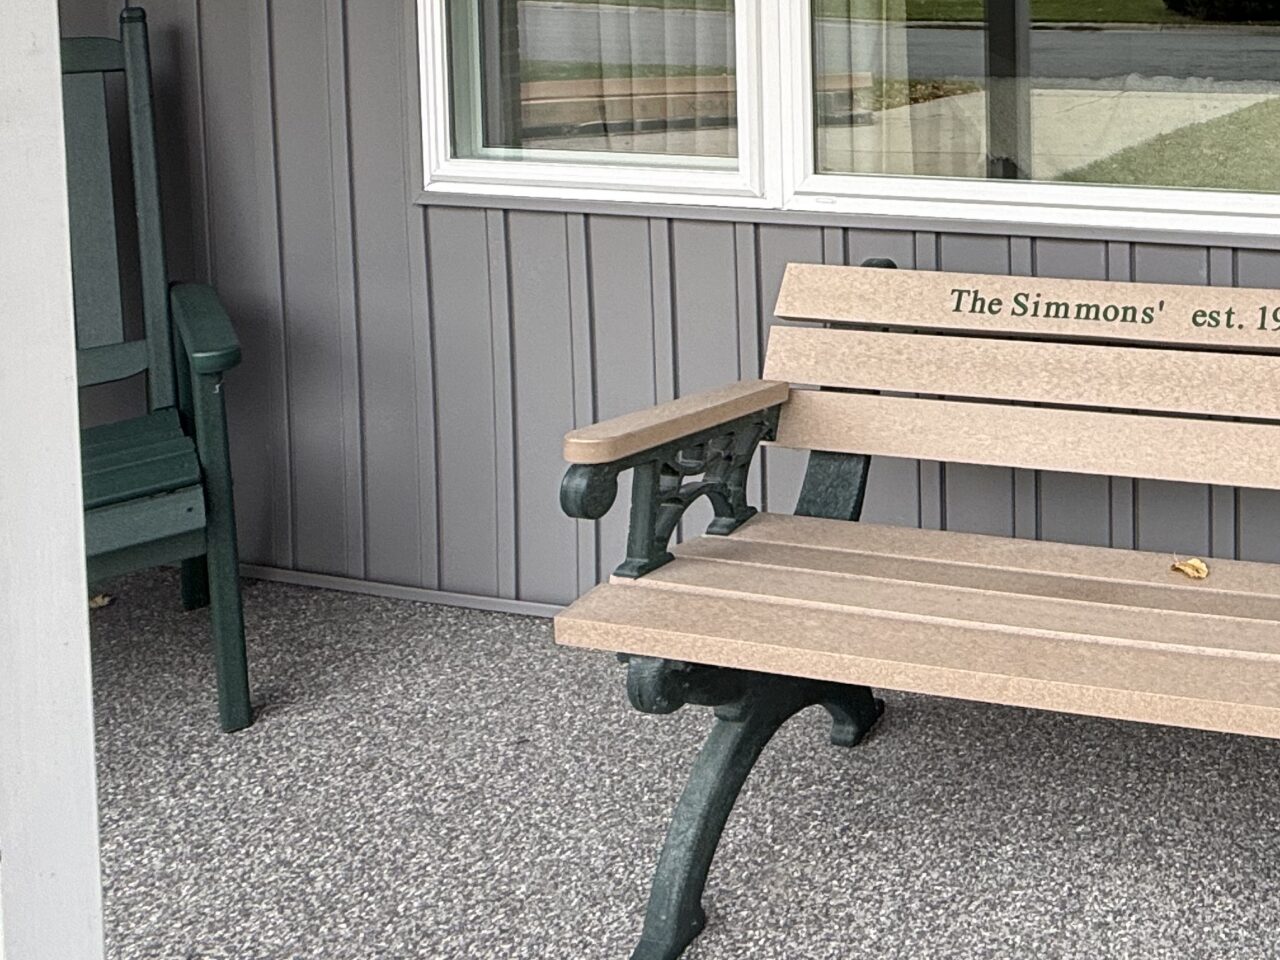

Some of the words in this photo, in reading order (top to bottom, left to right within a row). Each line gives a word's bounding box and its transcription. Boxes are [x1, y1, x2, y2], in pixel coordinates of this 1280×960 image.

[950, 288, 1003, 315] The
[1011, 292, 1165, 324] Simmons'
[1192, 306, 1244, 330] est.
